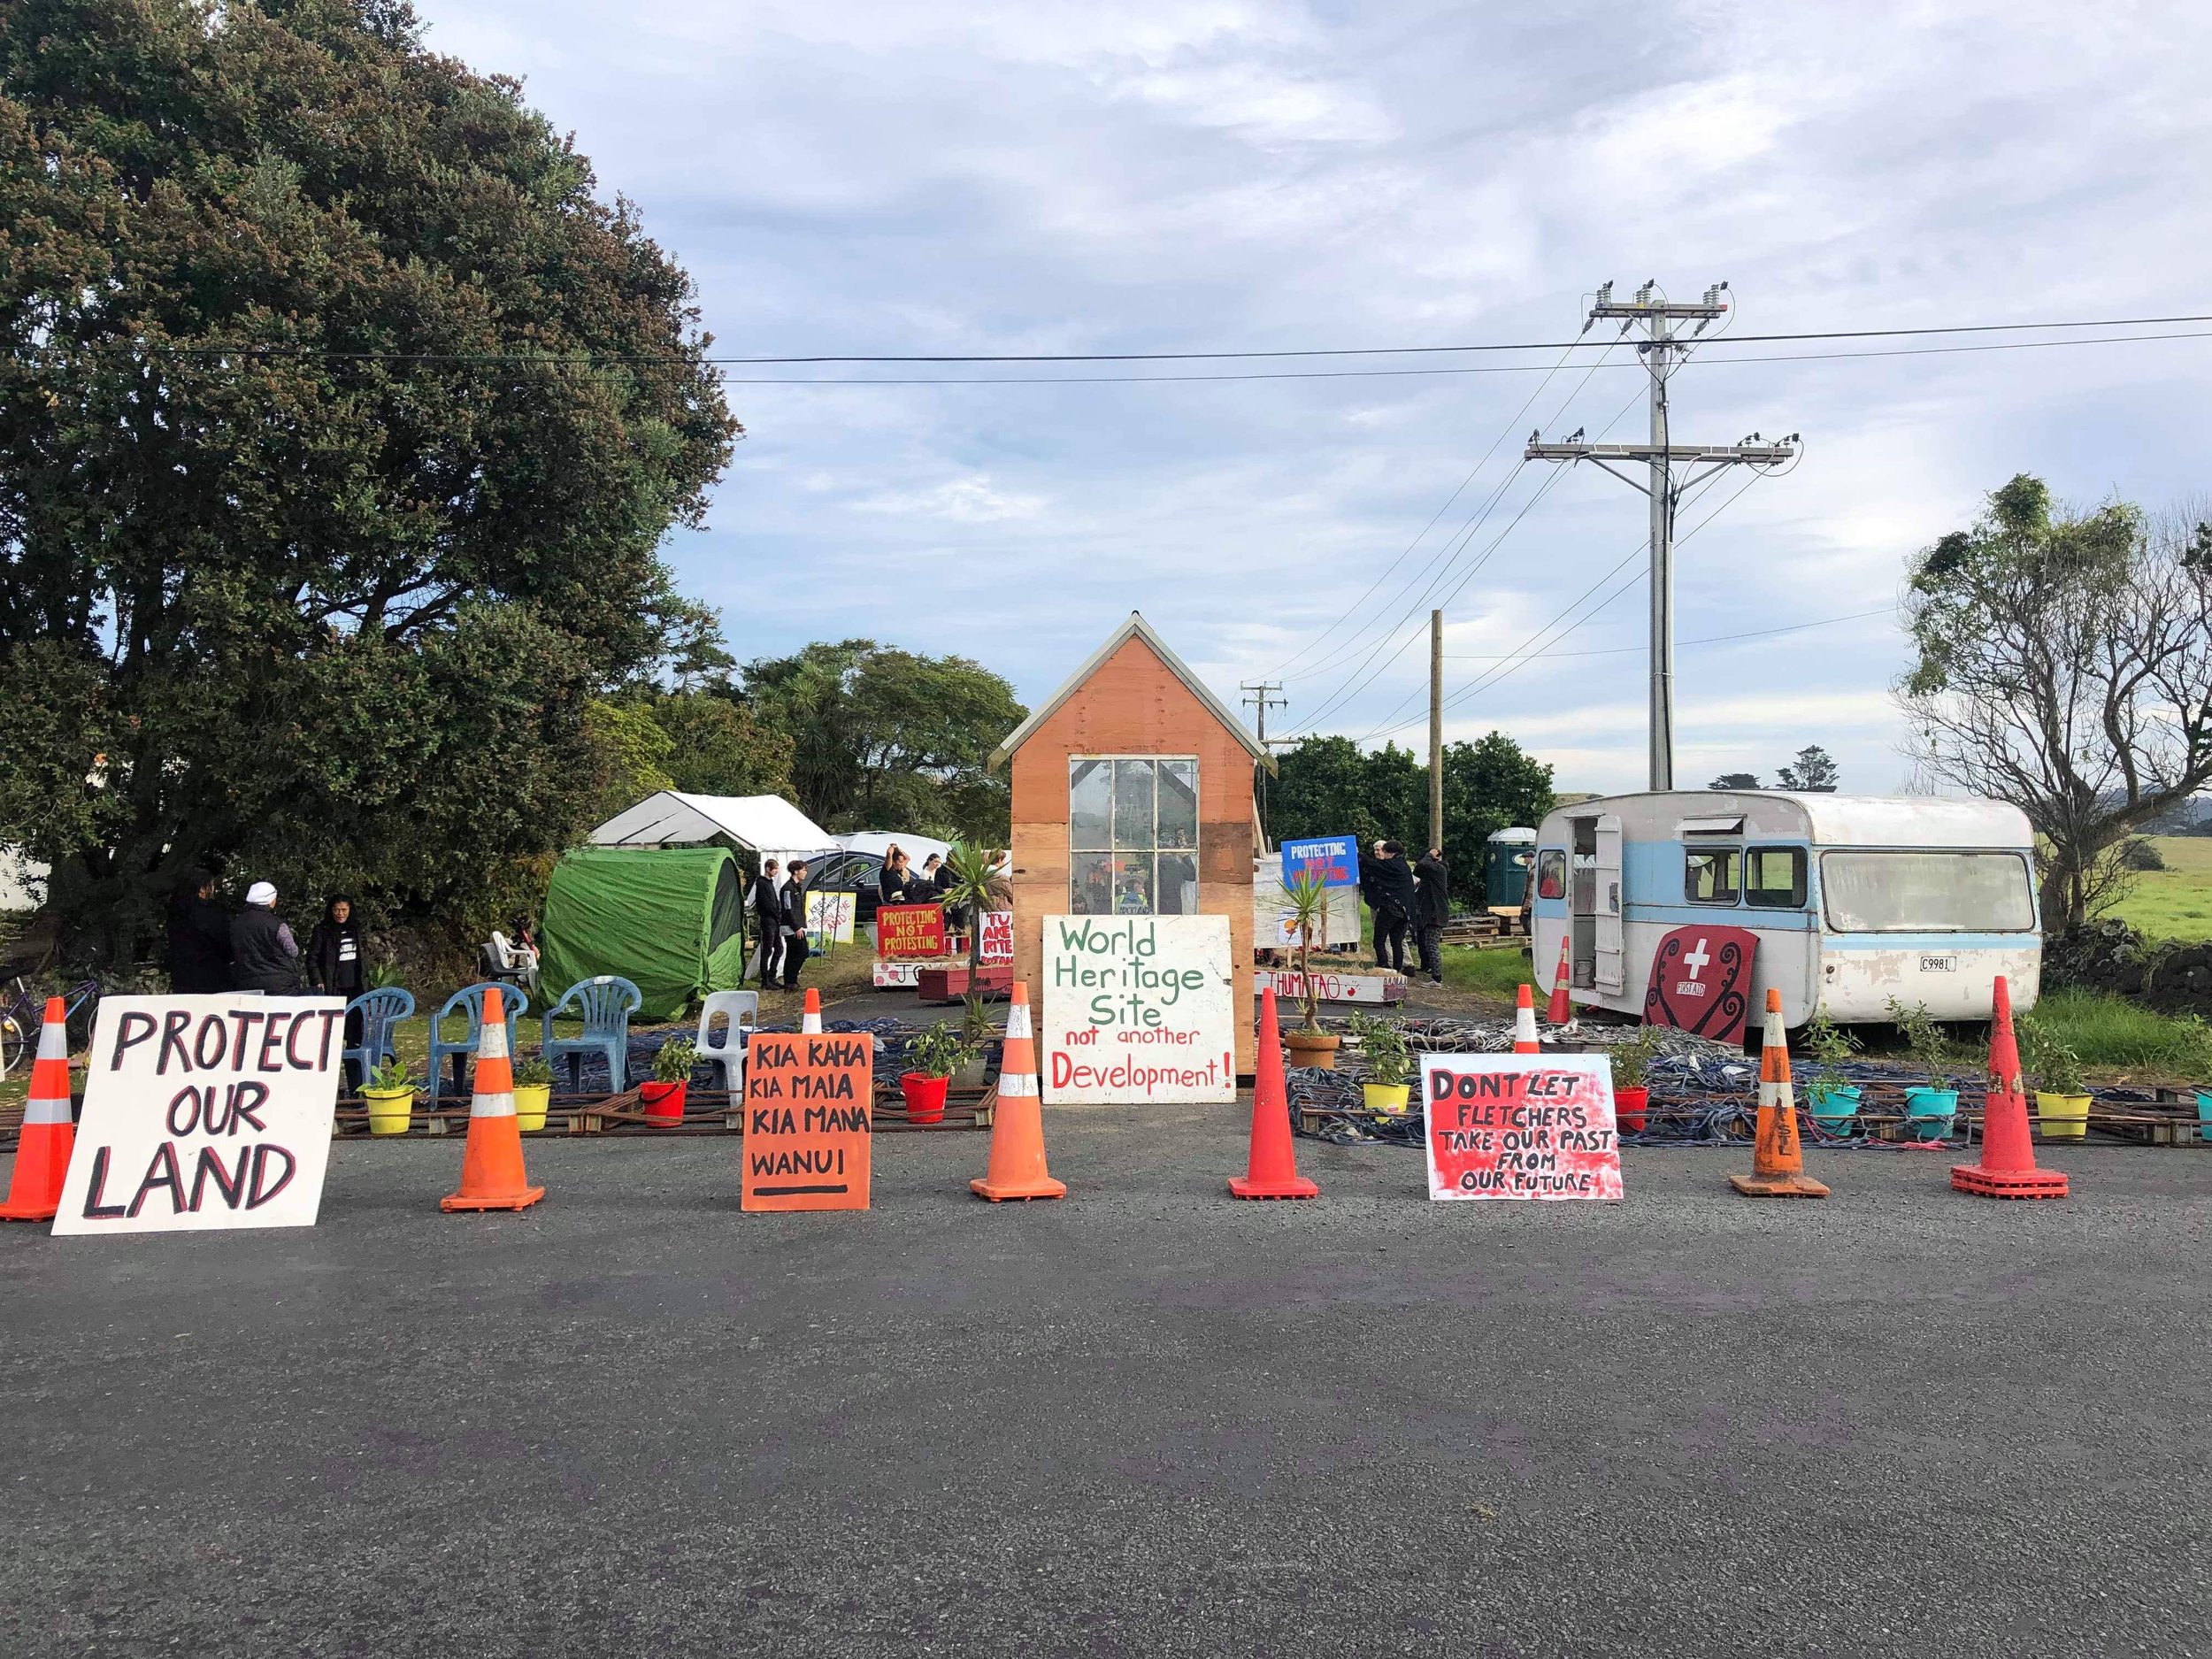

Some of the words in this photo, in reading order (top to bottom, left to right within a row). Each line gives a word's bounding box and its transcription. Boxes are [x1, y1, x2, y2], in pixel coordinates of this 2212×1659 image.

[1291, 841, 1347, 860] PROTECTING
[1304, 856, 1334, 869] NOT
[882, 910, 937, 926] PROTECTING
[987, 912, 1010, 926] TU
[895, 925, 926, 937] NOT
[982, 925, 1010, 940] AKE
[1059, 918, 1156, 957] World
[884, 934, 939, 951] PROTESTING
[983, 939, 1013, 954] RITE
[1922, 958, 1948, 970] C9981
[1056, 954, 1205, 1006] Heritage
[1678, 982, 1693, 994] FIRST
[1693, 983, 1705, 995] AID
[1087, 993, 1163, 1027] Site
[110, 1009, 345, 1076] PROTECT
[1065, 1025, 1100, 1046] not
[1117, 1025, 1202, 1045] another
[757, 1043, 798, 1070] KIA
[808, 1039, 866, 1068] KAHA
[1052, 1051, 1233, 1096] Development!
[749, 1075, 783, 1099] KIA
[792, 1072, 854, 1100] MAIA
[1432, 1070, 1520, 1102] DONT
[1527, 1073, 1580, 1096] LET
[165, 1080, 270, 1138] OUR
[752, 1108, 796, 1134] KIA
[804, 1105, 871, 1133] MANA
[1457, 1104, 1587, 1129] FLETCHERS
[1438, 1131, 1494, 1151] TAKE
[1503, 1129, 1549, 1151] OUR
[1560, 1129, 1613, 1151] PAST
[751, 1148, 844, 1177] WANUI
[1496, 1152, 1555, 1171] FROM
[81, 1141, 296, 1220] LAND
[1461, 1171, 1506, 1191] OUR
[1514, 1171, 1592, 1192] FUTURE
